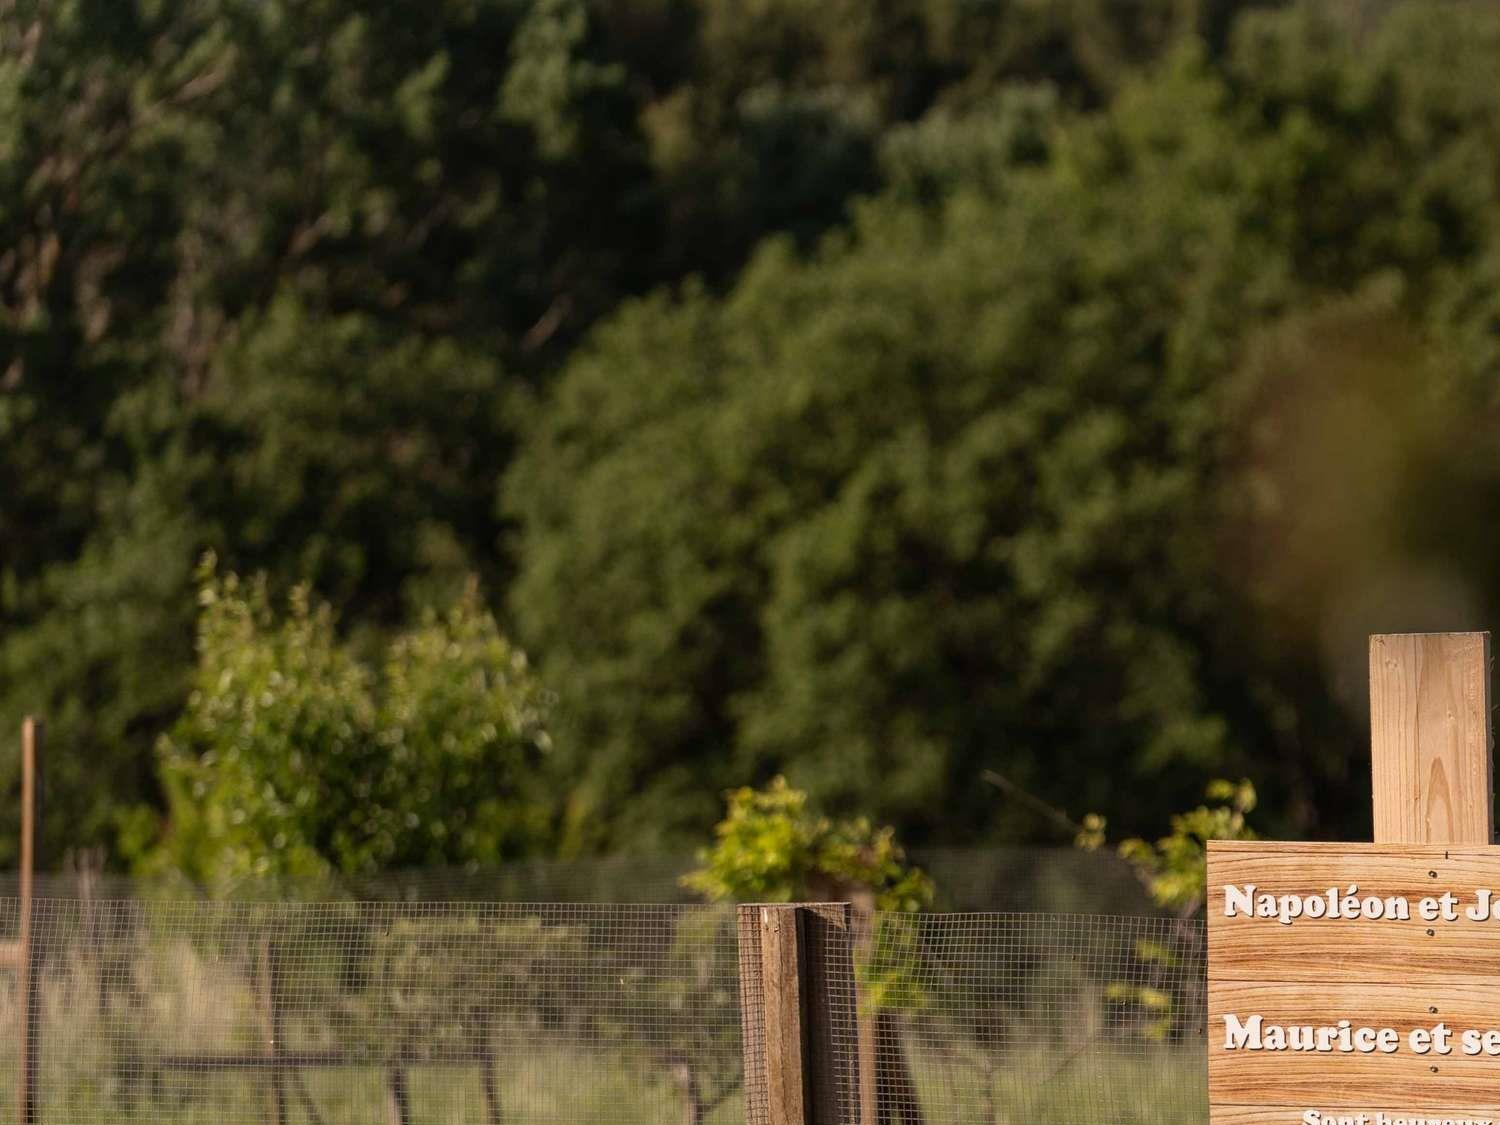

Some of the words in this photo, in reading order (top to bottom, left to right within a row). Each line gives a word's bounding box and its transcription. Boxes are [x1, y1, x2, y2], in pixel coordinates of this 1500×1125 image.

[1222, 884, 1410, 924] Napoléon
[1418, 895, 1458, 921] et
[1222, 1014, 1399, 1054] Maurice
[1408, 1022, 1452, 1054] et
